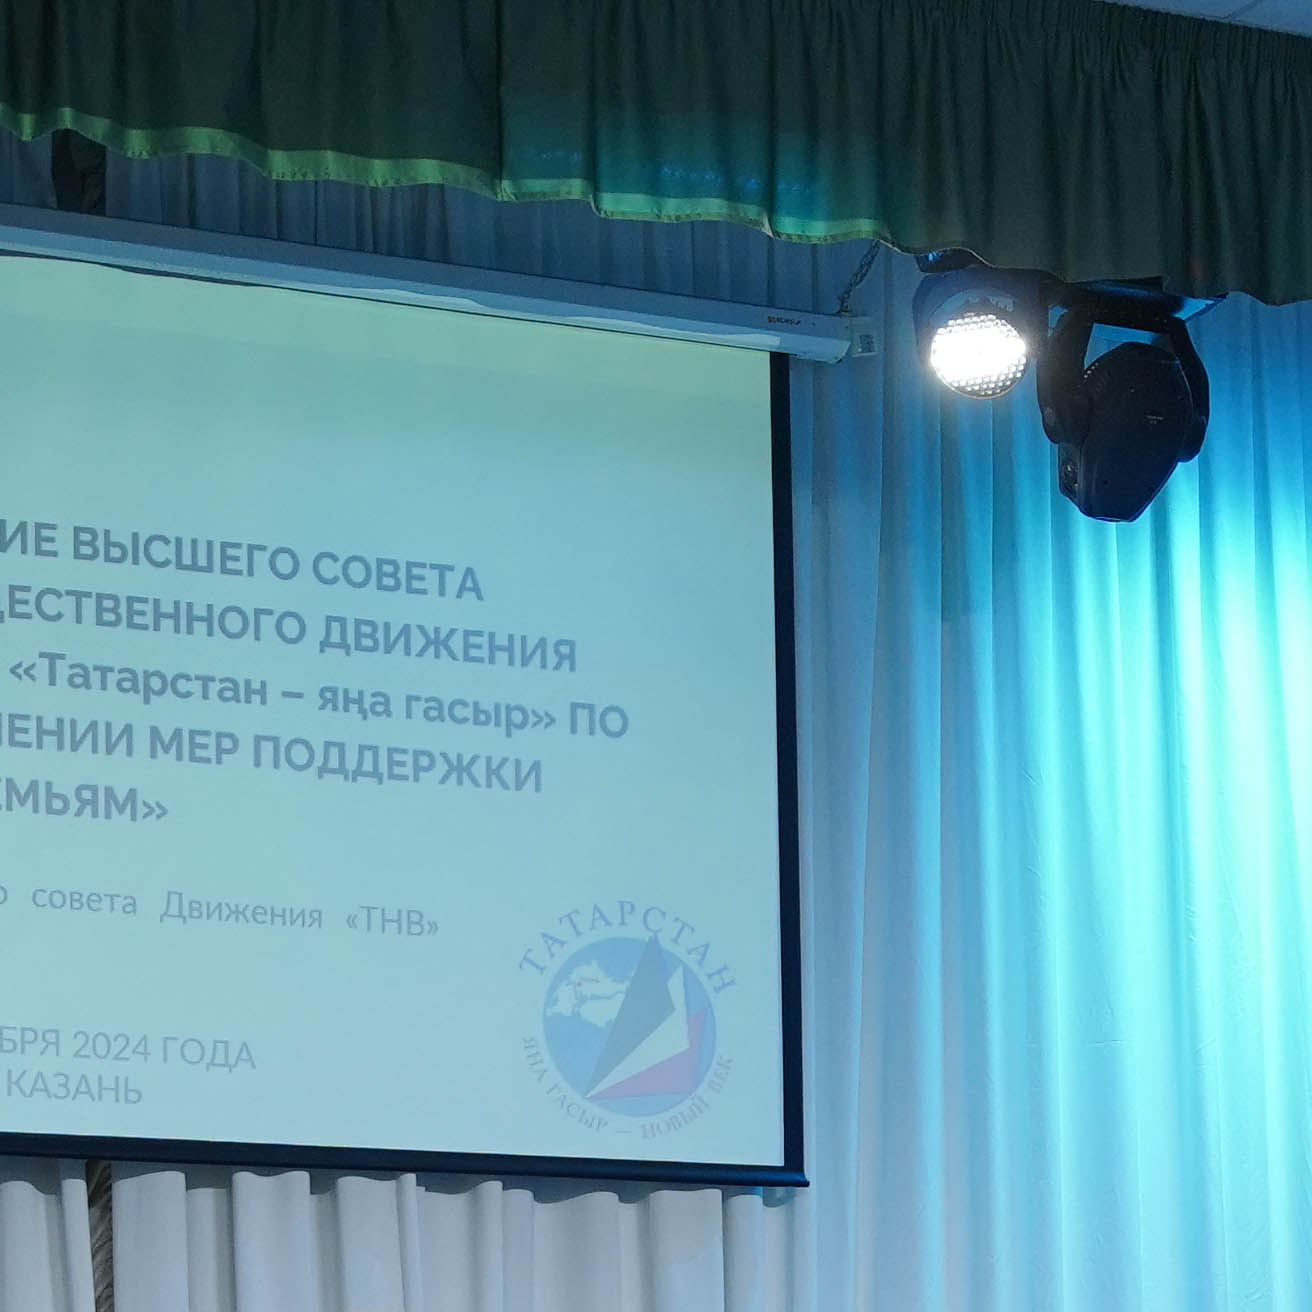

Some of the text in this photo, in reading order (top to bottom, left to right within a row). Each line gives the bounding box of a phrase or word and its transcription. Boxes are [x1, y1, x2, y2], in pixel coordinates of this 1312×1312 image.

[72, 526, 300, 581] ВЫСШЕГО
[312, 551, 484, 601] СОВЕТА
[320, 616, 577, 672] ДВИЖЕНИЯ
[10, 652, 267, 706] «Татарстан
[318, 684, 392, 721] яңа
[406, 694, 556, 737] гасыр»
[570, 704, 629, 738] ПО
[150, 728, 238, 767] МЕР
[253, 735, 542, 793] ПОДДЕРЖКИ
[31, 885, 137, 915] совета
[160, 889, 322, 929] Движения
[346, 905, 439, 937] «ТНВ»
[519, 900, 737, 995] ТАТАРСТАН
[72, 1031, 152, 1062] 2024
[162, 1036, 257, 1072] ГОДА
[6, 1069, 143, 1104] КАЗАНЬ
